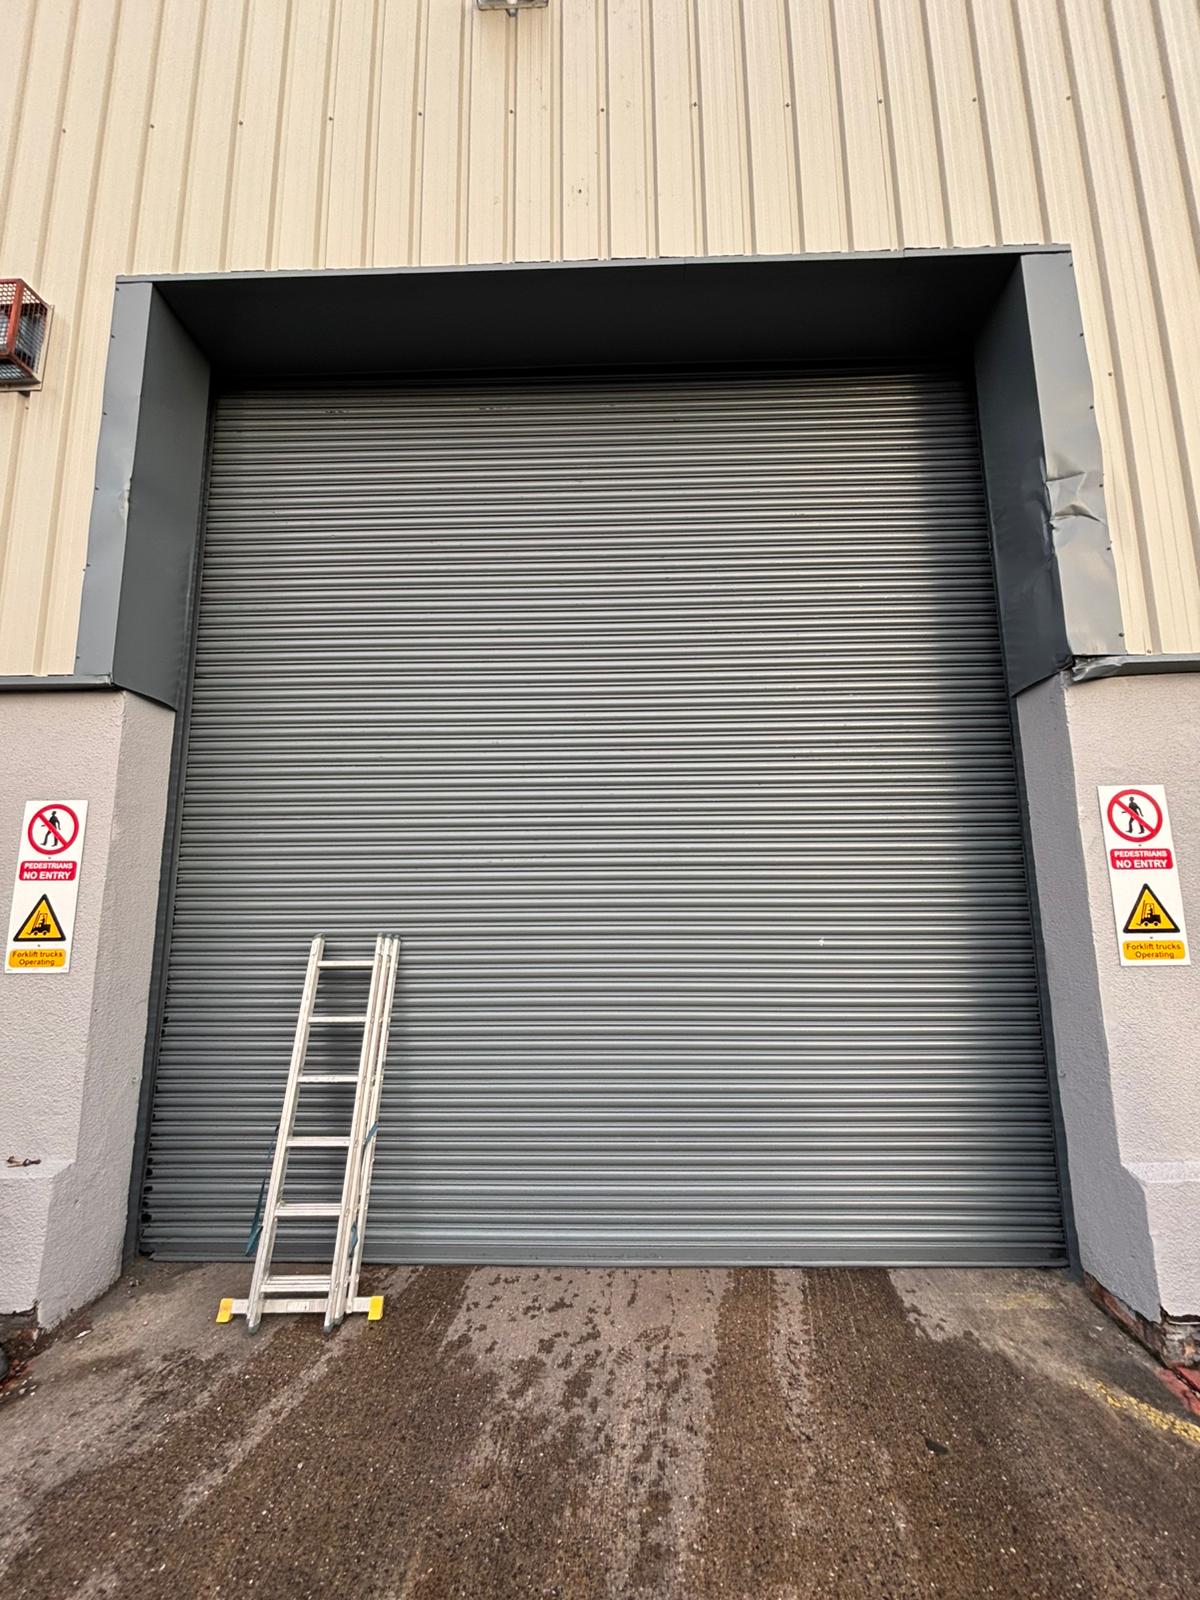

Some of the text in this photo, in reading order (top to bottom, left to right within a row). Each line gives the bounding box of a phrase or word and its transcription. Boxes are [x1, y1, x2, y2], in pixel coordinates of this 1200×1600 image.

[1116, 859, 1168, 868] NO ENTRY
[23, 871, 71, 880] NO ENTRY
[1135, 951, 1175, 959] Operating
[19, 958, 55, 966] Operating
